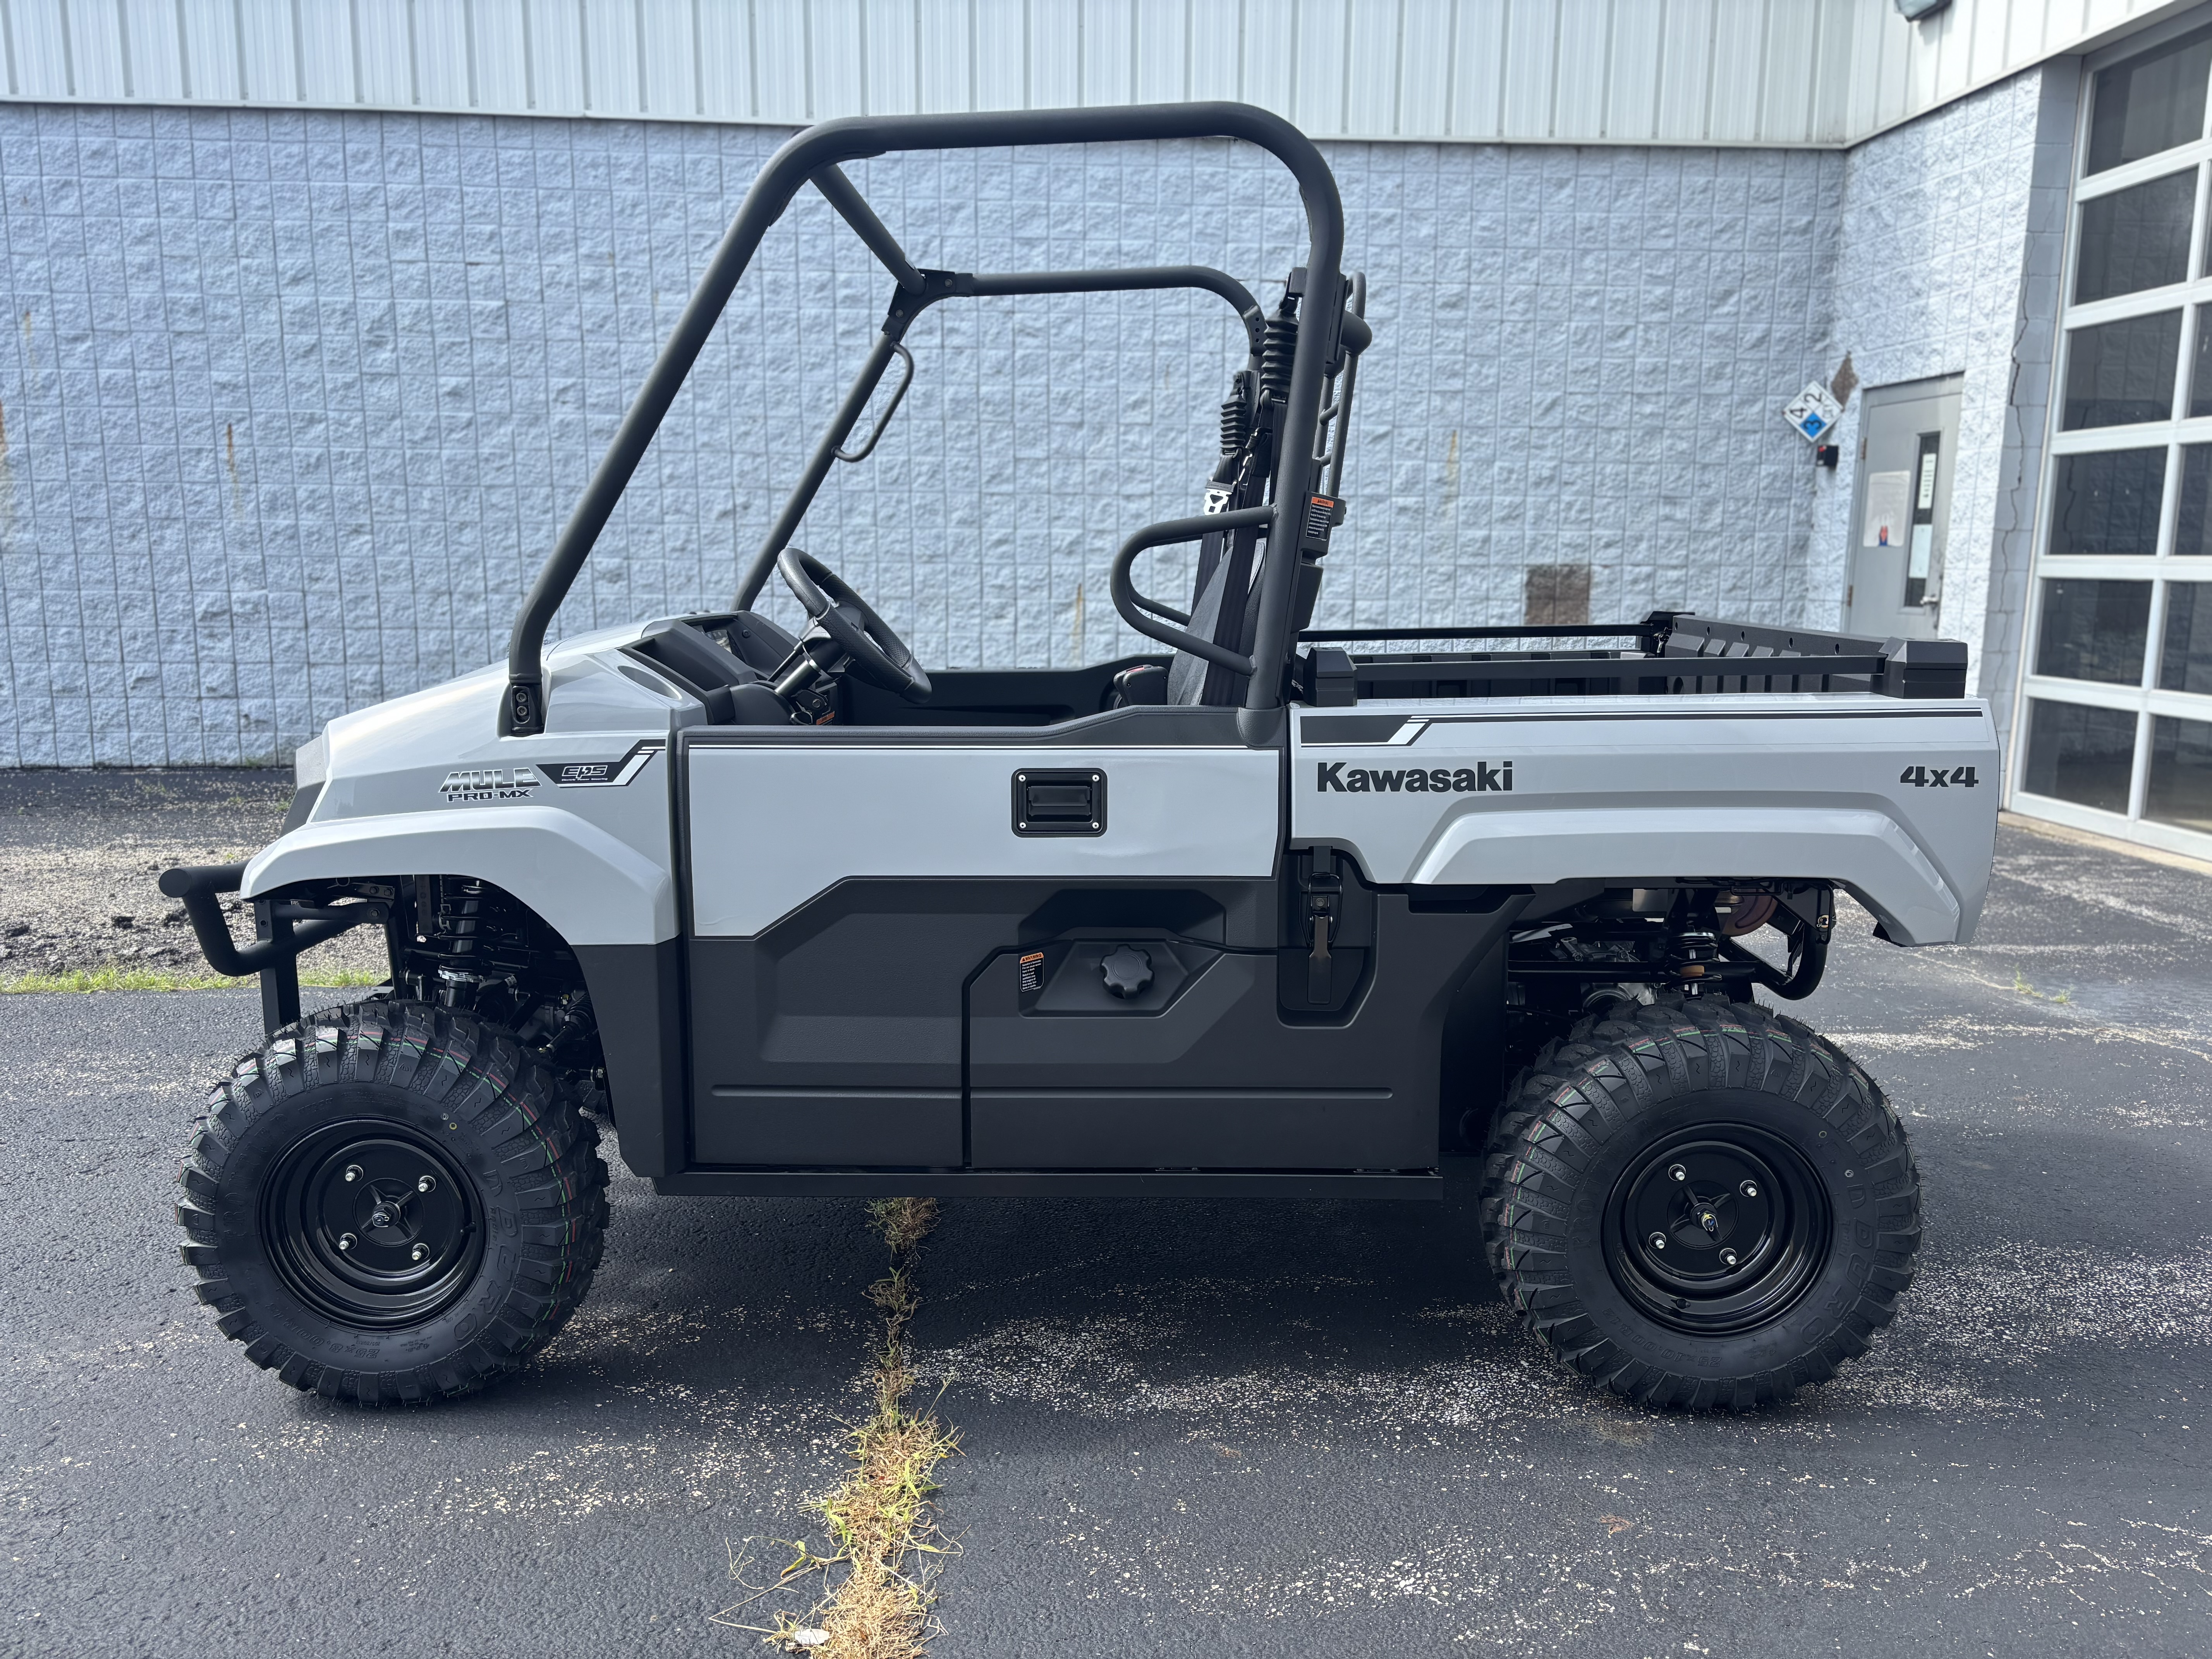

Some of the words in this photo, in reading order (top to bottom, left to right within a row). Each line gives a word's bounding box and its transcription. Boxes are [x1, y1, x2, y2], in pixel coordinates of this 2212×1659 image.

[1803, 421, 1822, 429] 3
[438, 767, 542, 793] MULE
[1317, 761, 1513, 793] Kawasaki
[1900, 766, 1979, 788] 4x4
[447, 788, 534, 803] PRO-MX
[454, 1205, 518, 1341] DURO
[1800, 1217, 1874, 1345] DURO
